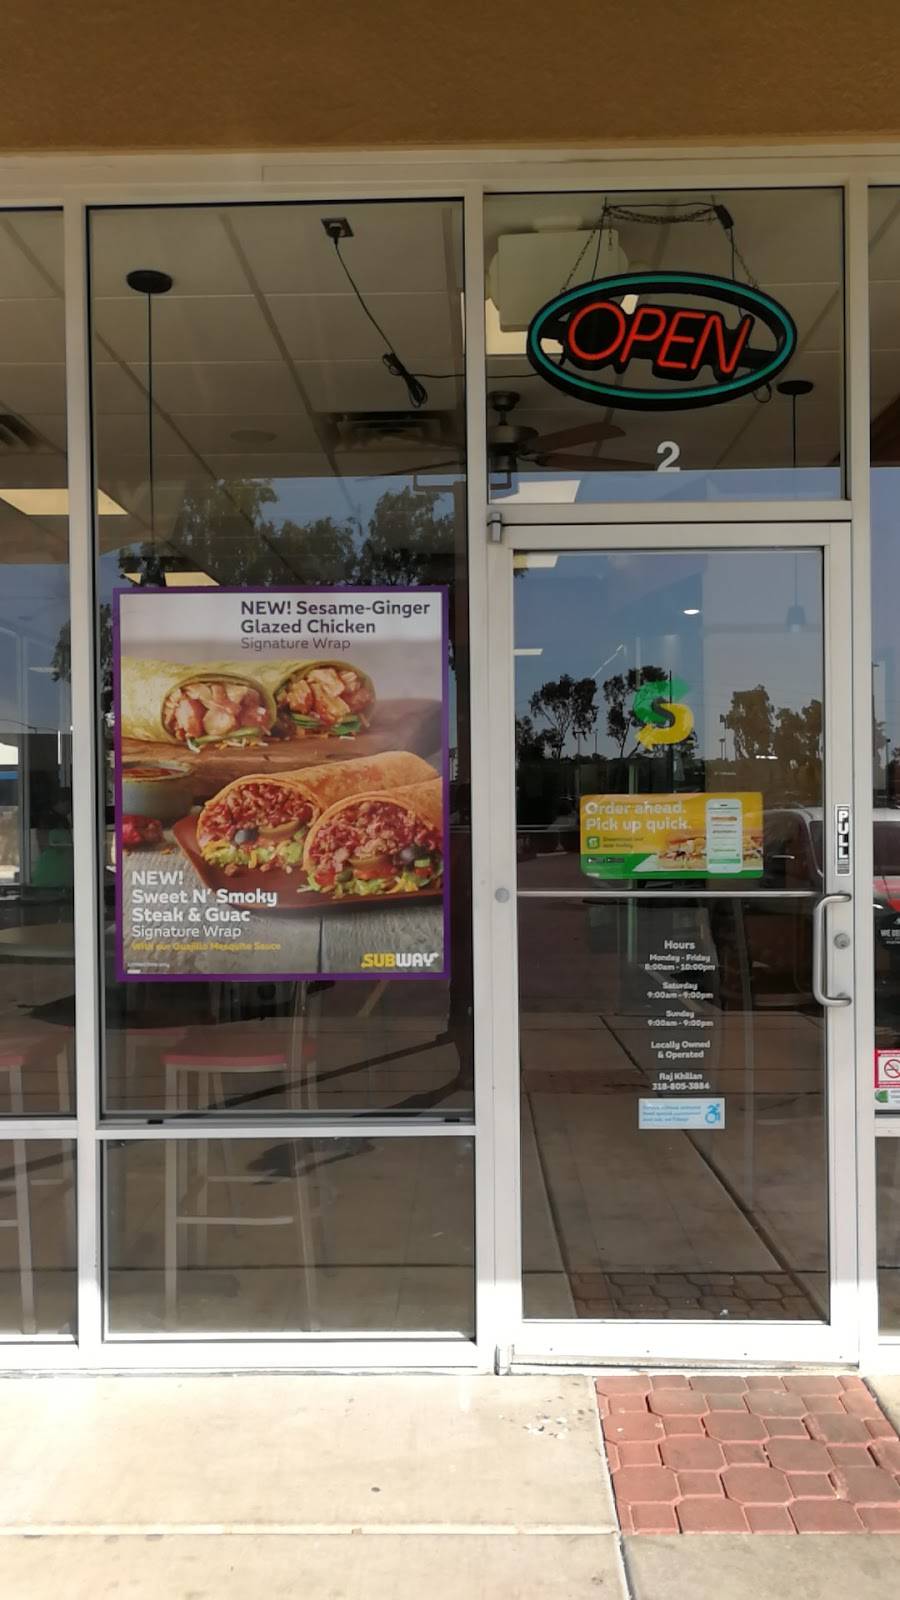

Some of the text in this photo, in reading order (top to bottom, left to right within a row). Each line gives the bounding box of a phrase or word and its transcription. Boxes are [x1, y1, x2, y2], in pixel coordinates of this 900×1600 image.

[568, 302, 752, 374] OPEN
[656, 440, 681, 473] 2
[241, 600, 430, 618] NEW! Sesame-Ginger
[241, 619, 376, 634] Glazed Chicken
[240, 637, 351, 652] Signature Wrap
[585, 800, 686, 815] Order ahead.
[586, 817, 692, 833] Pick up quick.
[838, 810, 849, 859] PULL
[131, 870, 184, 886] NEW!
[131, 889, 188, 904] Sweet
[216, 888, 278, 907] Smoky
[131, 907, 251, 922] Steak & Guac
[131, 925, 242, 941] Signature Wrap
[664, 940, 696, 950] Hours
[361, 952, 440, 969] SUBWAY
[649, 953, 680, 963] Monday
[686, 953, 711, 963] Friday
[680, 963, 716, 972] 10:00pm
[662, 982, 698, 991] Saturday
[647, 991, 678, 999] 9:00am
[682, 991, 714, 1000] 9:00pm
[665, 1010, 695, 1019] Sunday
[647, 1019, 678, 1027] 9:00am
[682, 1019, 714, 1028] 9:00pm
[651, 1040, 711, 1050] Locally Owned
[657, 1050, 705, 1060] & Operated
[659, 1072, 673, 1082] Raj
